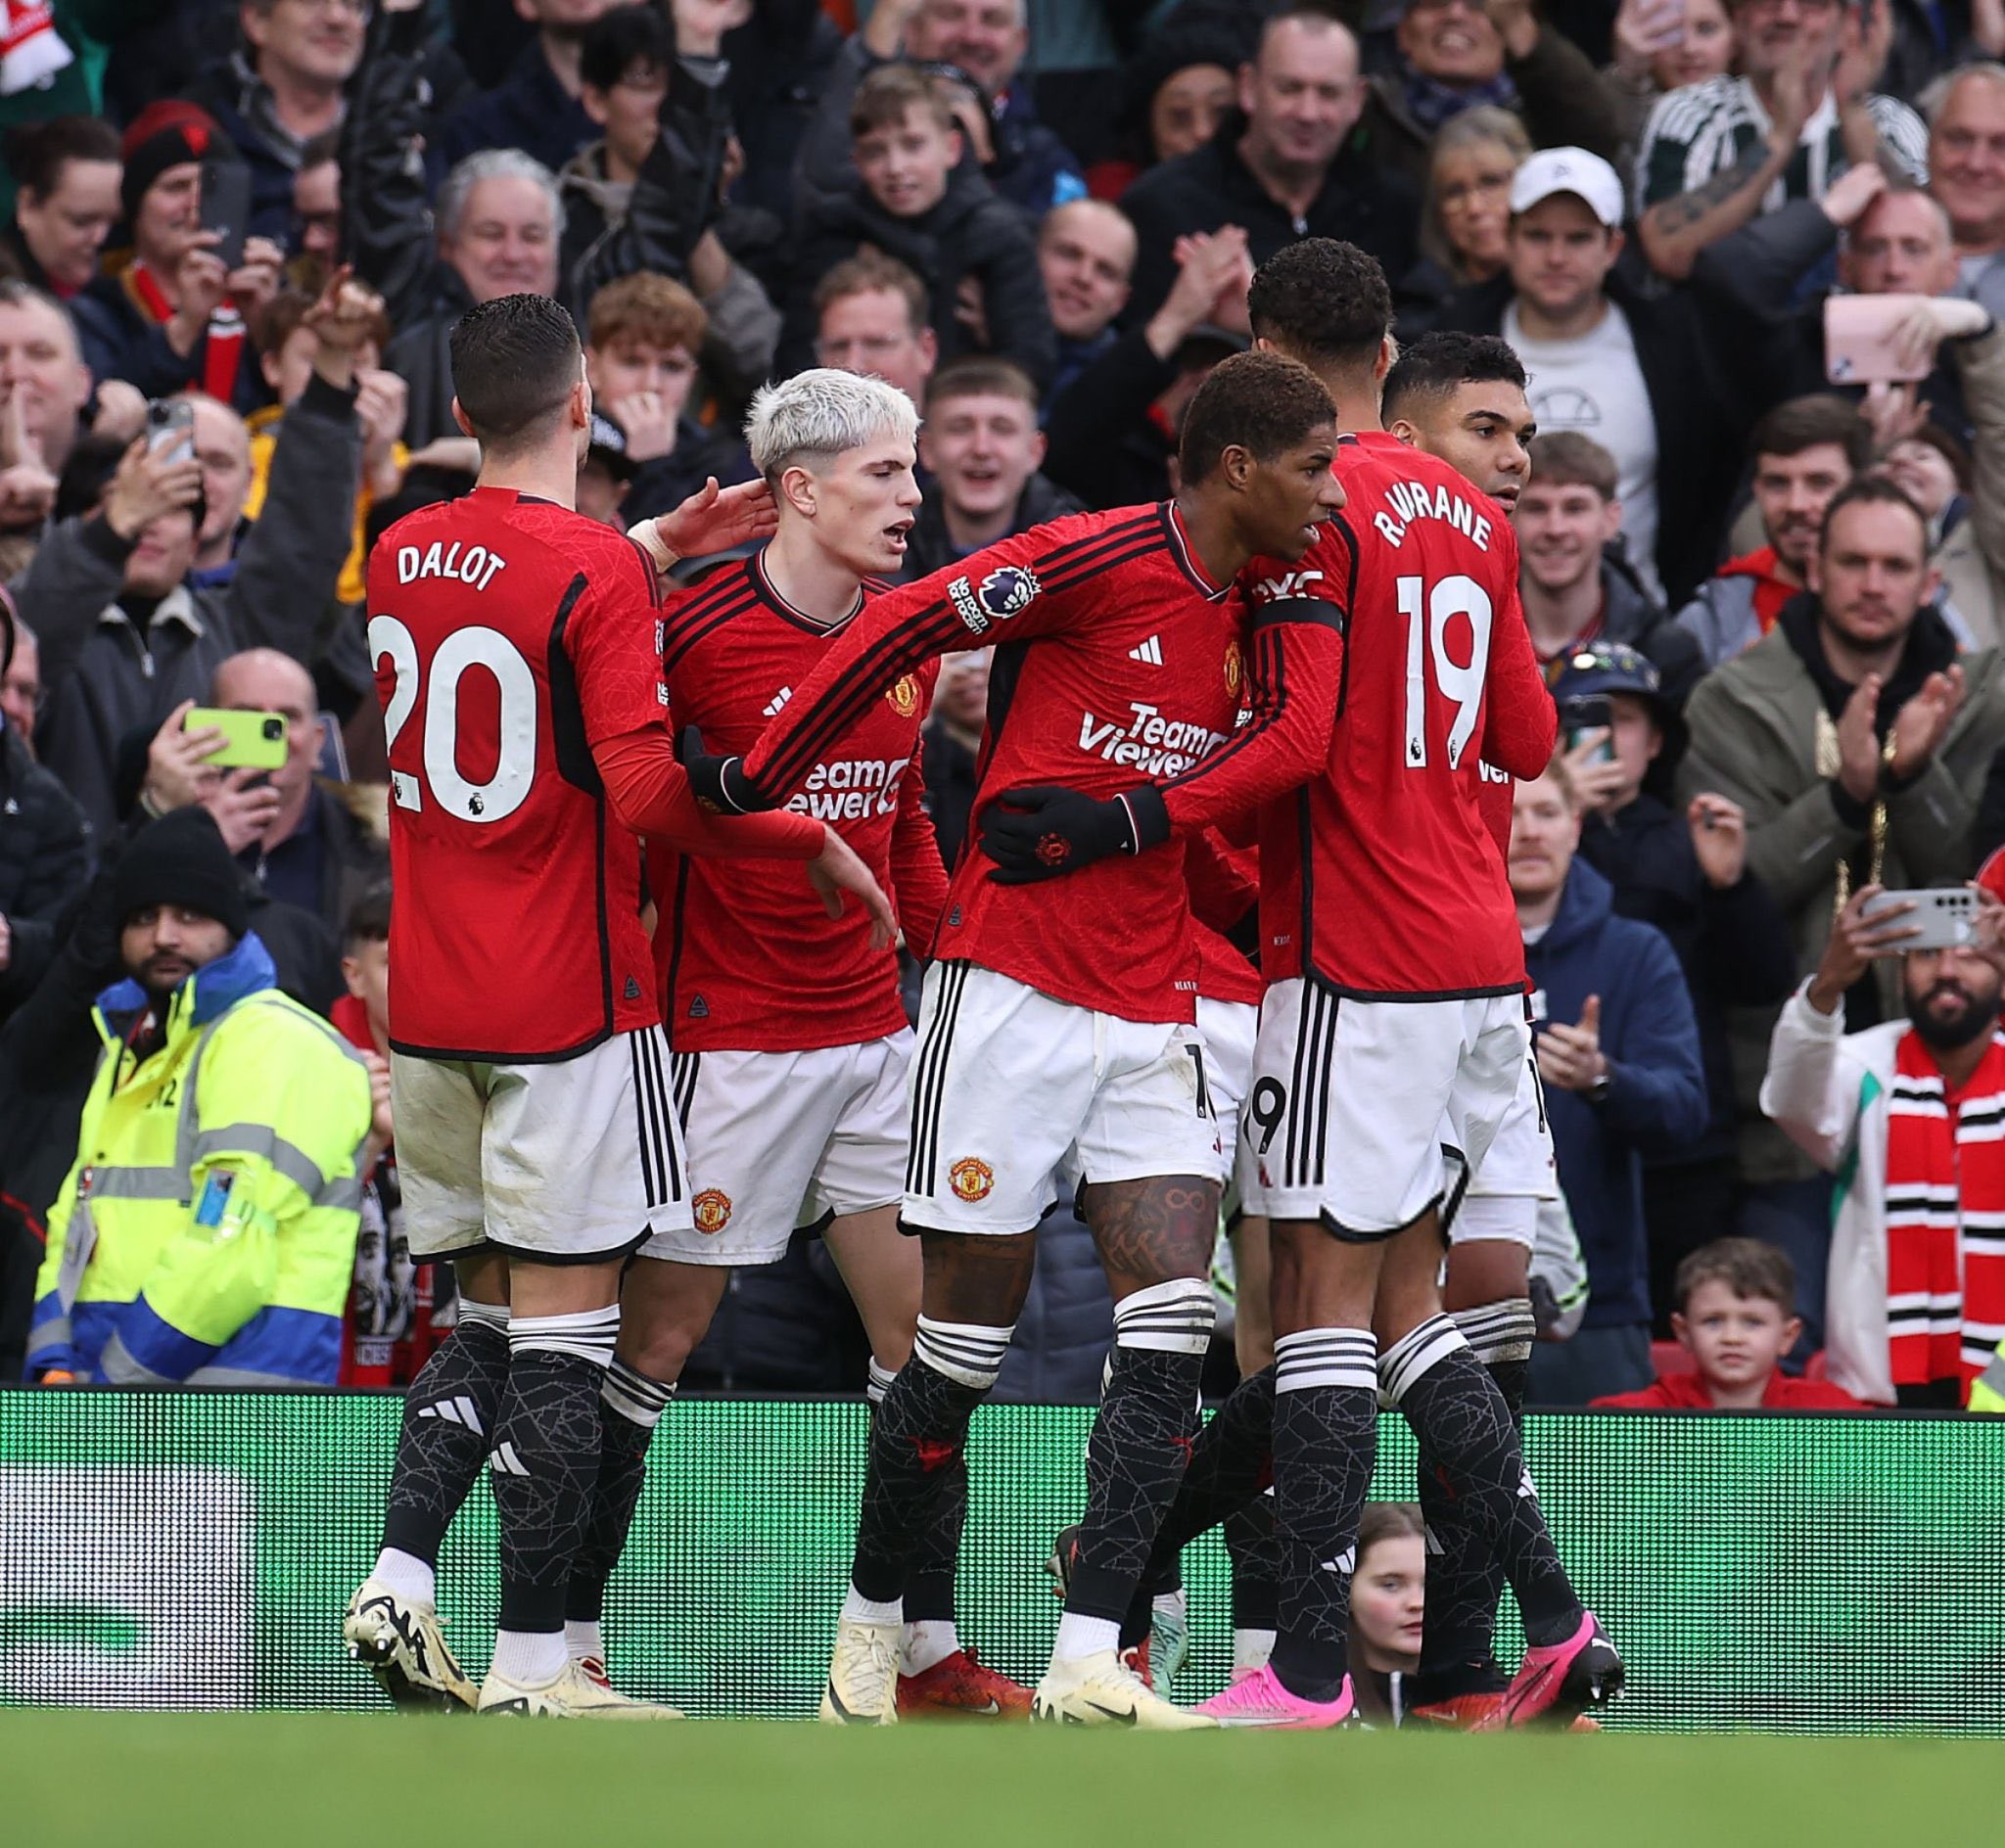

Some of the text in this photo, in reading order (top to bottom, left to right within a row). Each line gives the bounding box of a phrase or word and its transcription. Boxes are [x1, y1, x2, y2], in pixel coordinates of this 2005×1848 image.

[397, 541, 506, 591] DALOT
[963, 594, 989, 627] room
[1396, 575, 1493, 770] 19
[367, 615, 537, 823] 20
[1128, 702, 1208, 755] Team
[805, 761, 886, 790] eam
[782, 792, 878, 820] ewer
[1242, 1077, 1286, 1155] 9
